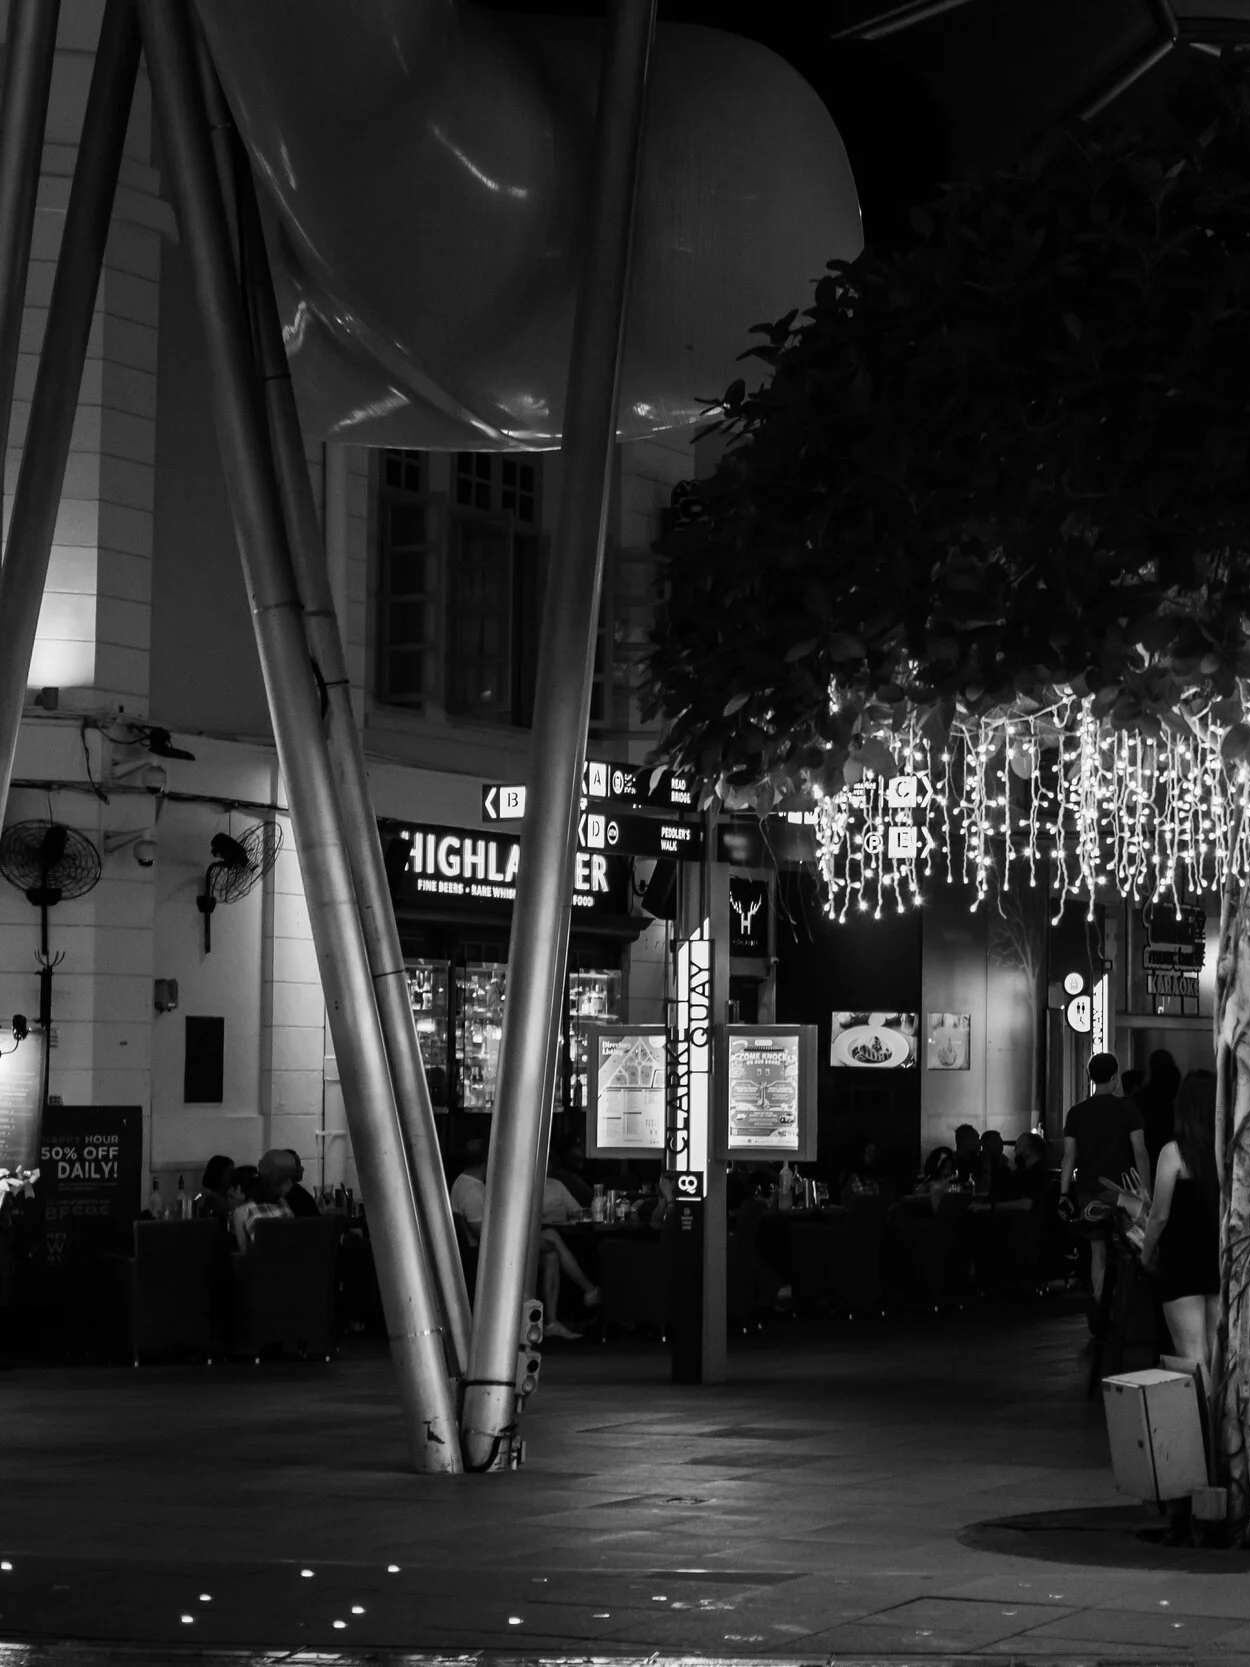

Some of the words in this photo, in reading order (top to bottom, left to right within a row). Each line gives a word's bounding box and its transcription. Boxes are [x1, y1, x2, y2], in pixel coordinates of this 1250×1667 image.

[593, 769, 601, 786] A
[671, 777, 686, 790] READ
[896, 781, 910, 797] C
[507, 792, 518, 807] B
[671, 791, 690, 804] BRIDGE
[592, 826, 600, 837] D
[661, 827, 690, 840] PEDDLER'S
[661, 840, 677, 851] WALK
[402, 831, 609, 892] HIGHLAER
[417, 879, 437, 892] FINE
[438, 881, 464, 895] BEERS
[471, 884, 492, 897] RARE
[572, 894, 594, 907] FOOD
[690, 959, 711, 1047] QUAY
[741, 1052, 761, 1061] COME
[666, 1026, 688, 1155] CLARKE
[84, 1135, 119, 1144] HOUR
[41, 1147, 78, 1160] 50%
[82, 1147, 119, 1160] OFF
[57, 1161, 118, 1179] DAILY!
